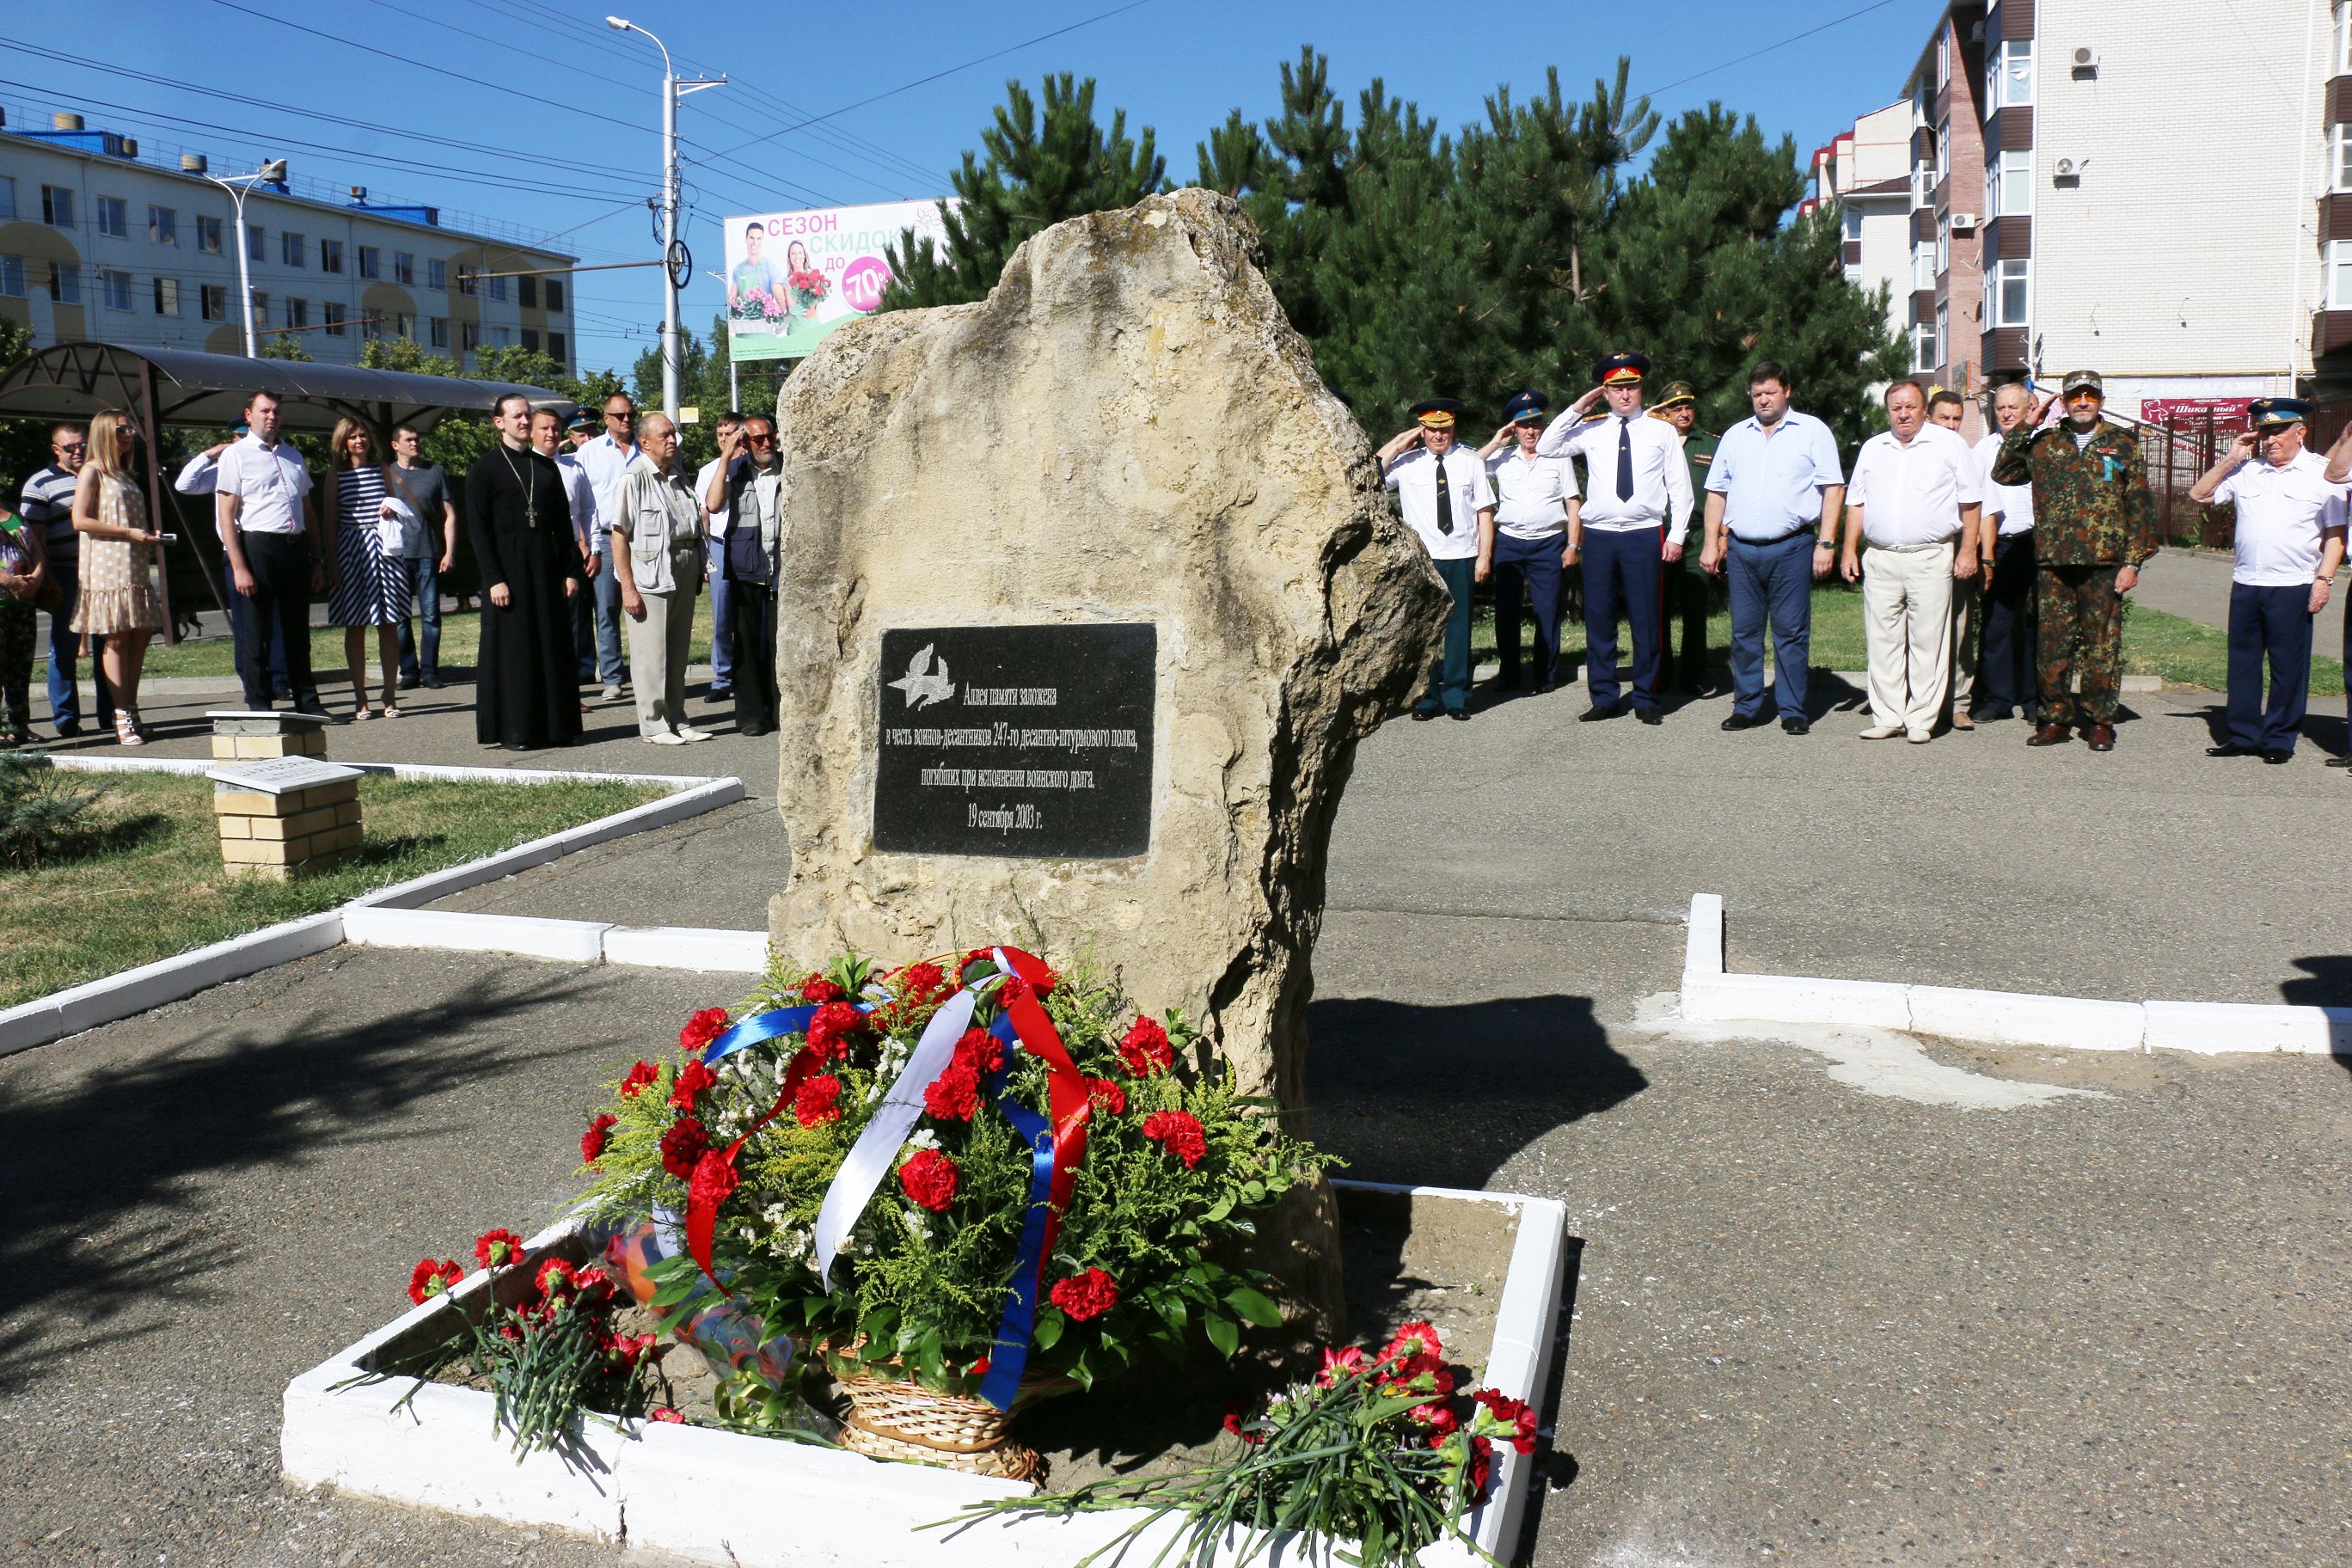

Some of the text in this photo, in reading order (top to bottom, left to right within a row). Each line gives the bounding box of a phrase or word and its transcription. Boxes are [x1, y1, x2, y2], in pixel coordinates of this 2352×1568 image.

[768, 214, 837, 237] СЕЗОН
[809, 228, 903, 254] СКИДОК
[825, 256, 845, 273] ДО
[2170, 403, 2243, 413] “Шиканый”
[964, 681, 1057, 706] Аллея памяти заложена
[885, 721, 1138, 754] в честь воинов-десантников 247-го десантно-штурмового полка,
[921, 761, 1095, 793] погибших при исполнении воинского долга.
[968, 802, 1043, 836] 19 сентября 2003 г.
